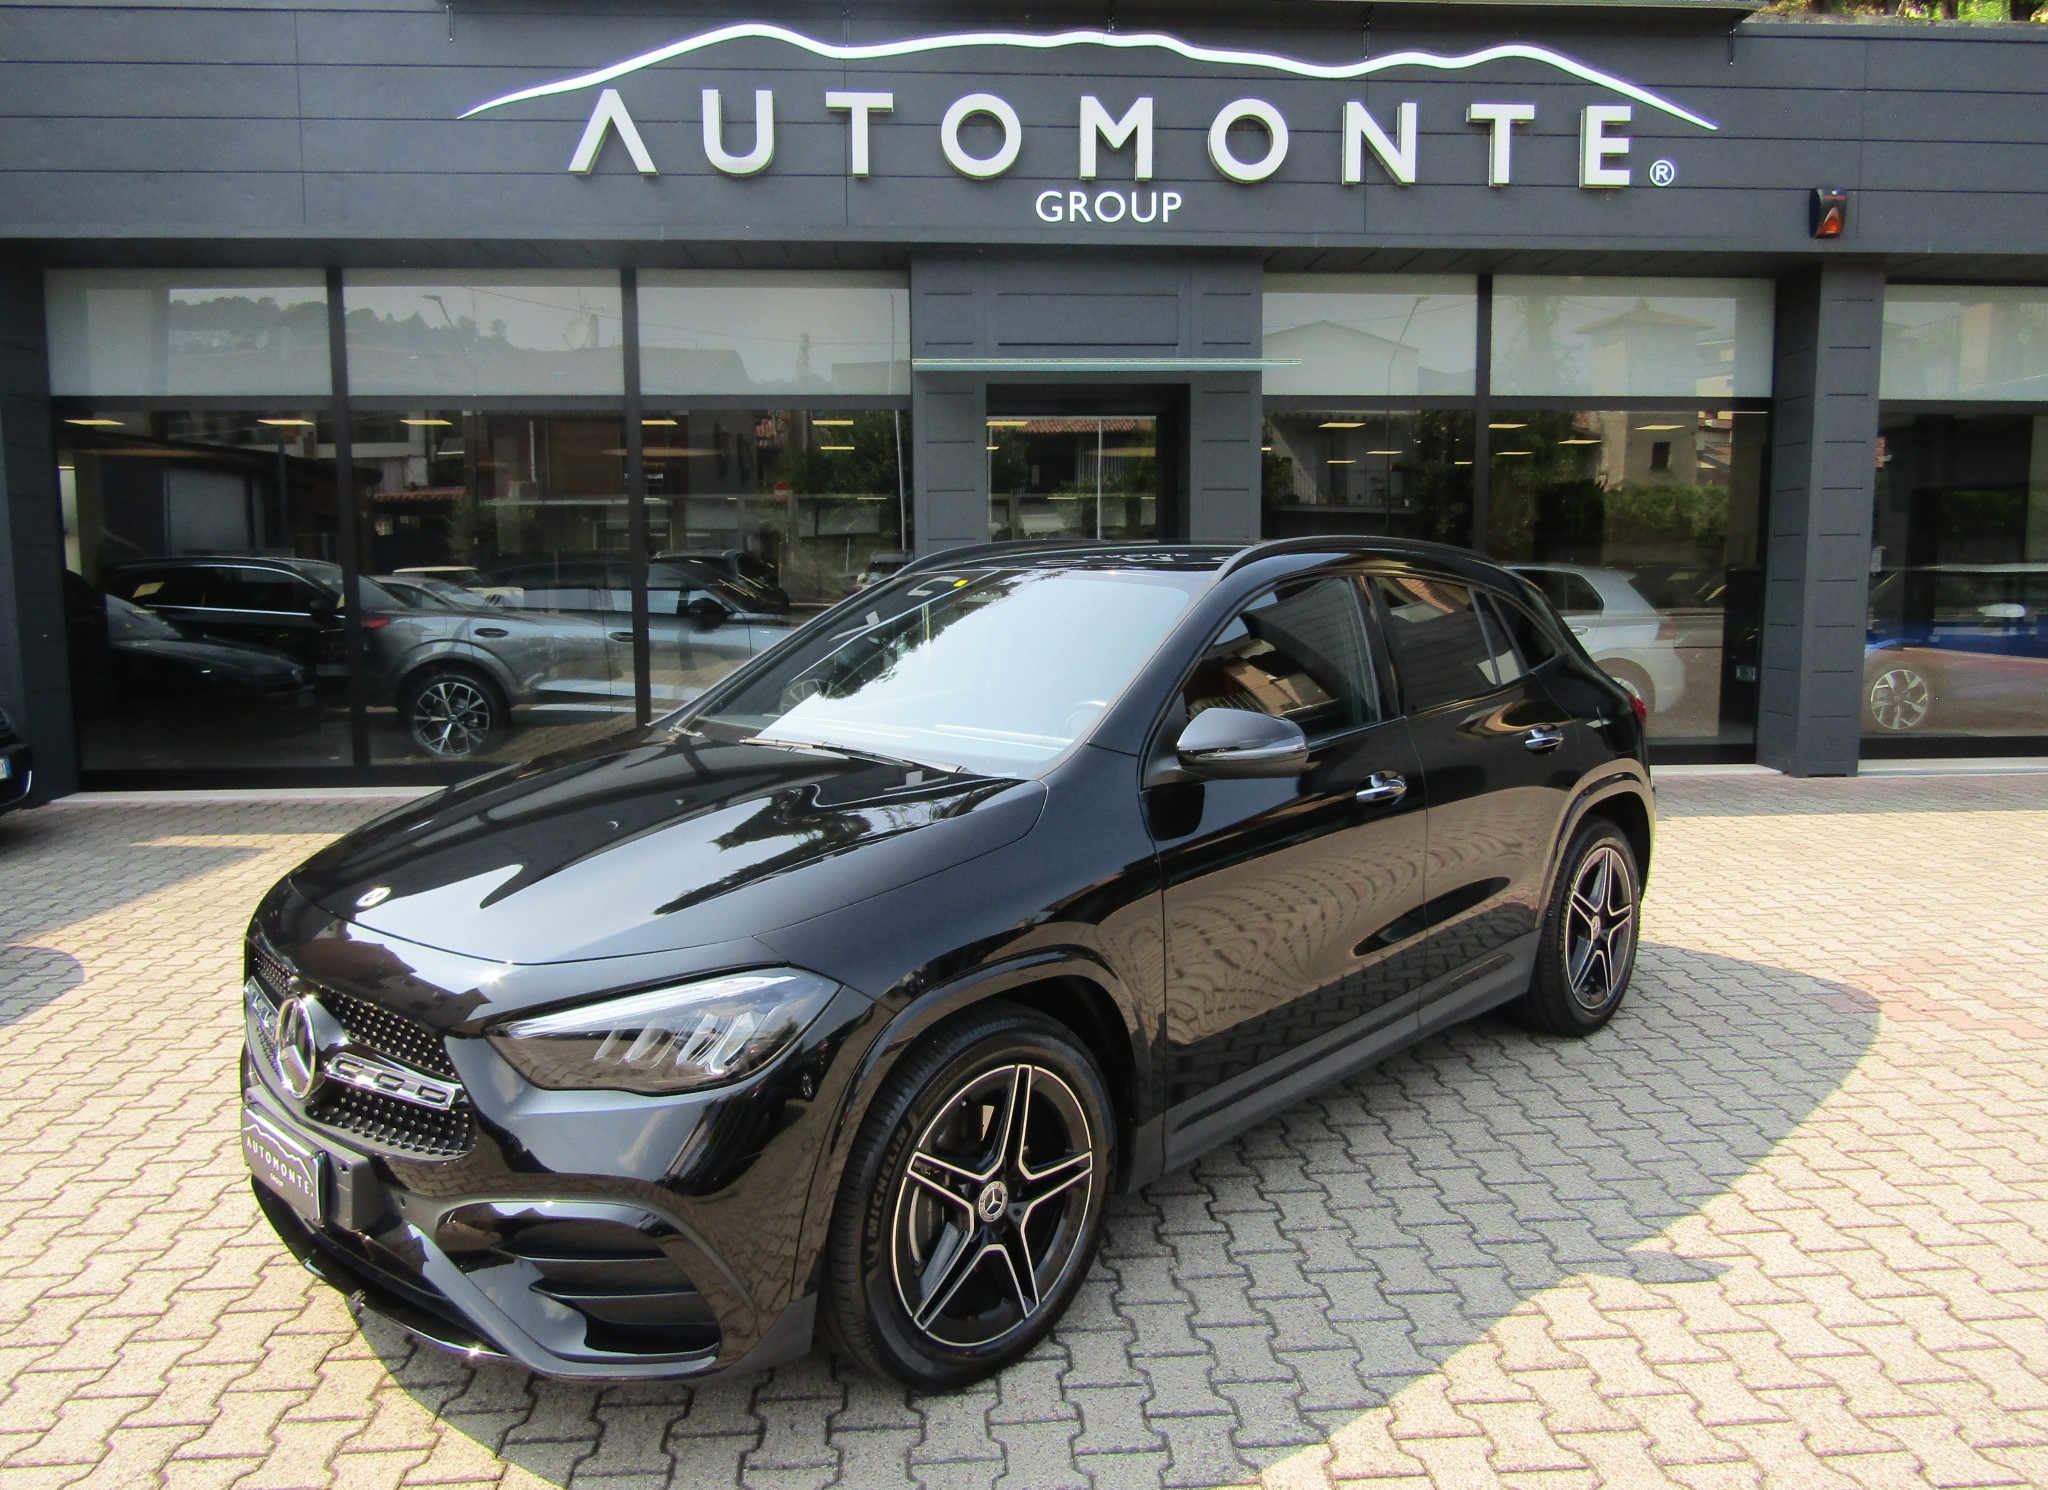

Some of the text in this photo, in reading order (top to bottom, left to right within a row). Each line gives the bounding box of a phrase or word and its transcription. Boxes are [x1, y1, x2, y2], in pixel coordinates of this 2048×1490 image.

[569, 88, 1632, 190] AUTOMONTE
[1035, 190, 1182, 224] GROUP
[247, 1136, 309, 1194] AUTOMONTE
[867, 1125, 908, 1239] MICHELIN
